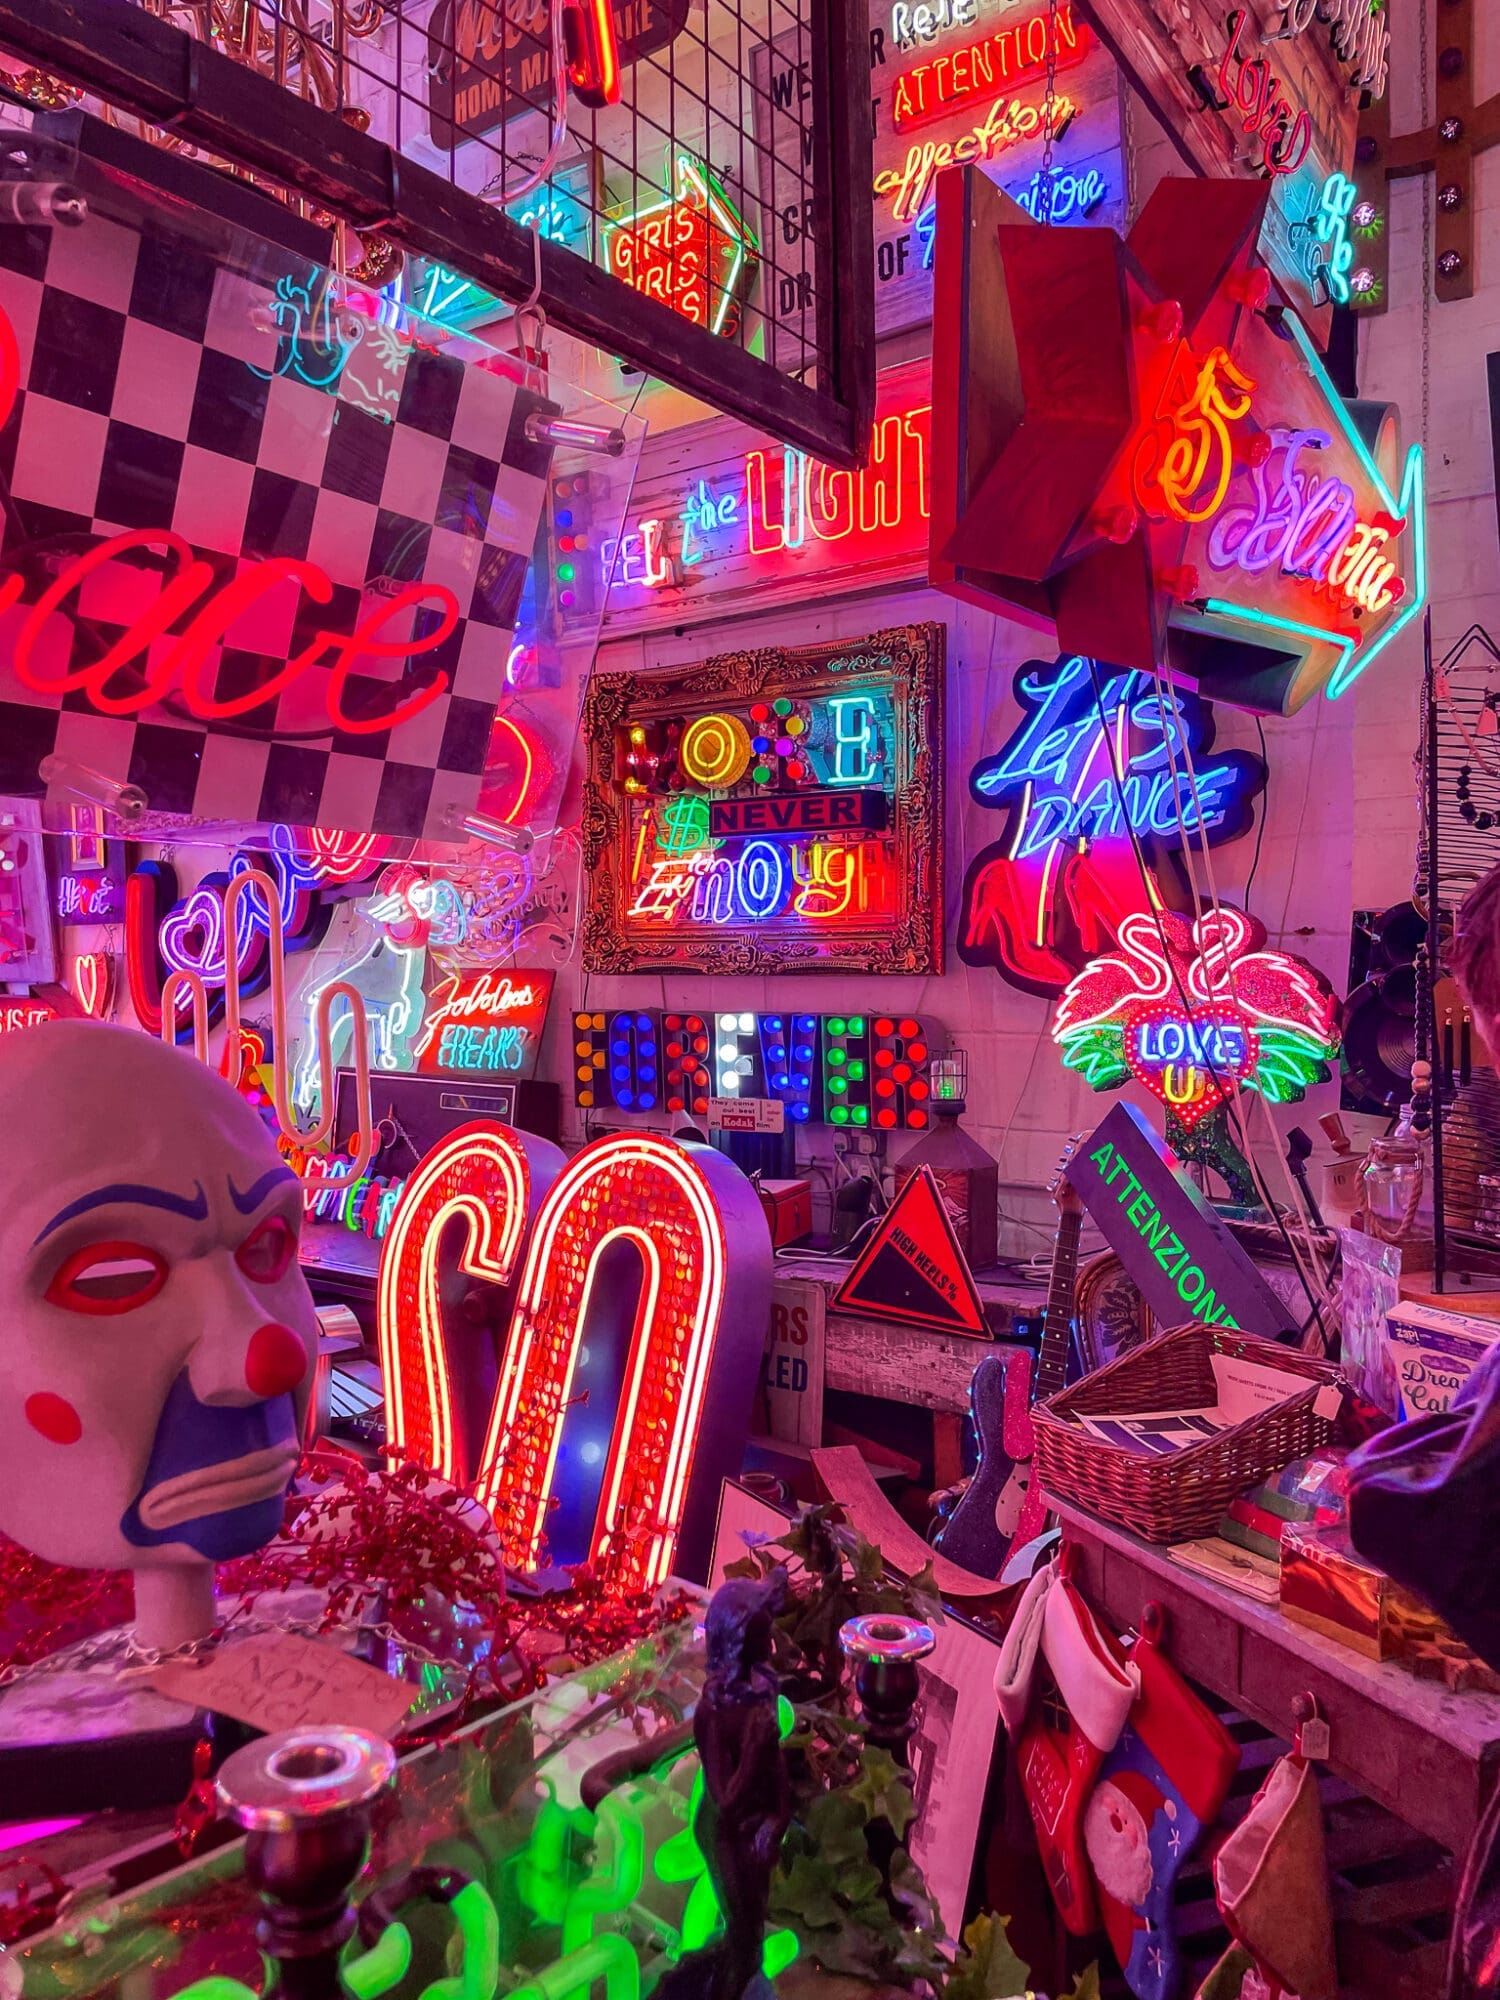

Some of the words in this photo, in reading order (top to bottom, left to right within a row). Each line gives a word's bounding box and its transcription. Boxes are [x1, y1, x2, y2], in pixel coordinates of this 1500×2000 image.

[894, 8, 1077, 121] ATTENTION
[455, 67, 513, 126] HOME
[873, 95, 1079, 220] affection
[616, 207, 694, 267] GIRLS
[878, 234, 911, 282] OF
[623, 251, 700, 299] IRLS
[0, 527, 460, 735] ace
[713, 796, 859, 832] NEVER
[1018, 766, 1230, 859] DANCE
[572, 1010, 932, 1132] FOREVER
[1141, 1022, 1242, 1062] LOVE
[723, 1116, 754, 1128] Kodak
[889, 1225, 919, 1258] HIGH
[913, 1250, 950, 1290] HEELS
[1401, 1359, 1465, 1390] Drea
[1403, 1384, 1451, 1413] Cat
